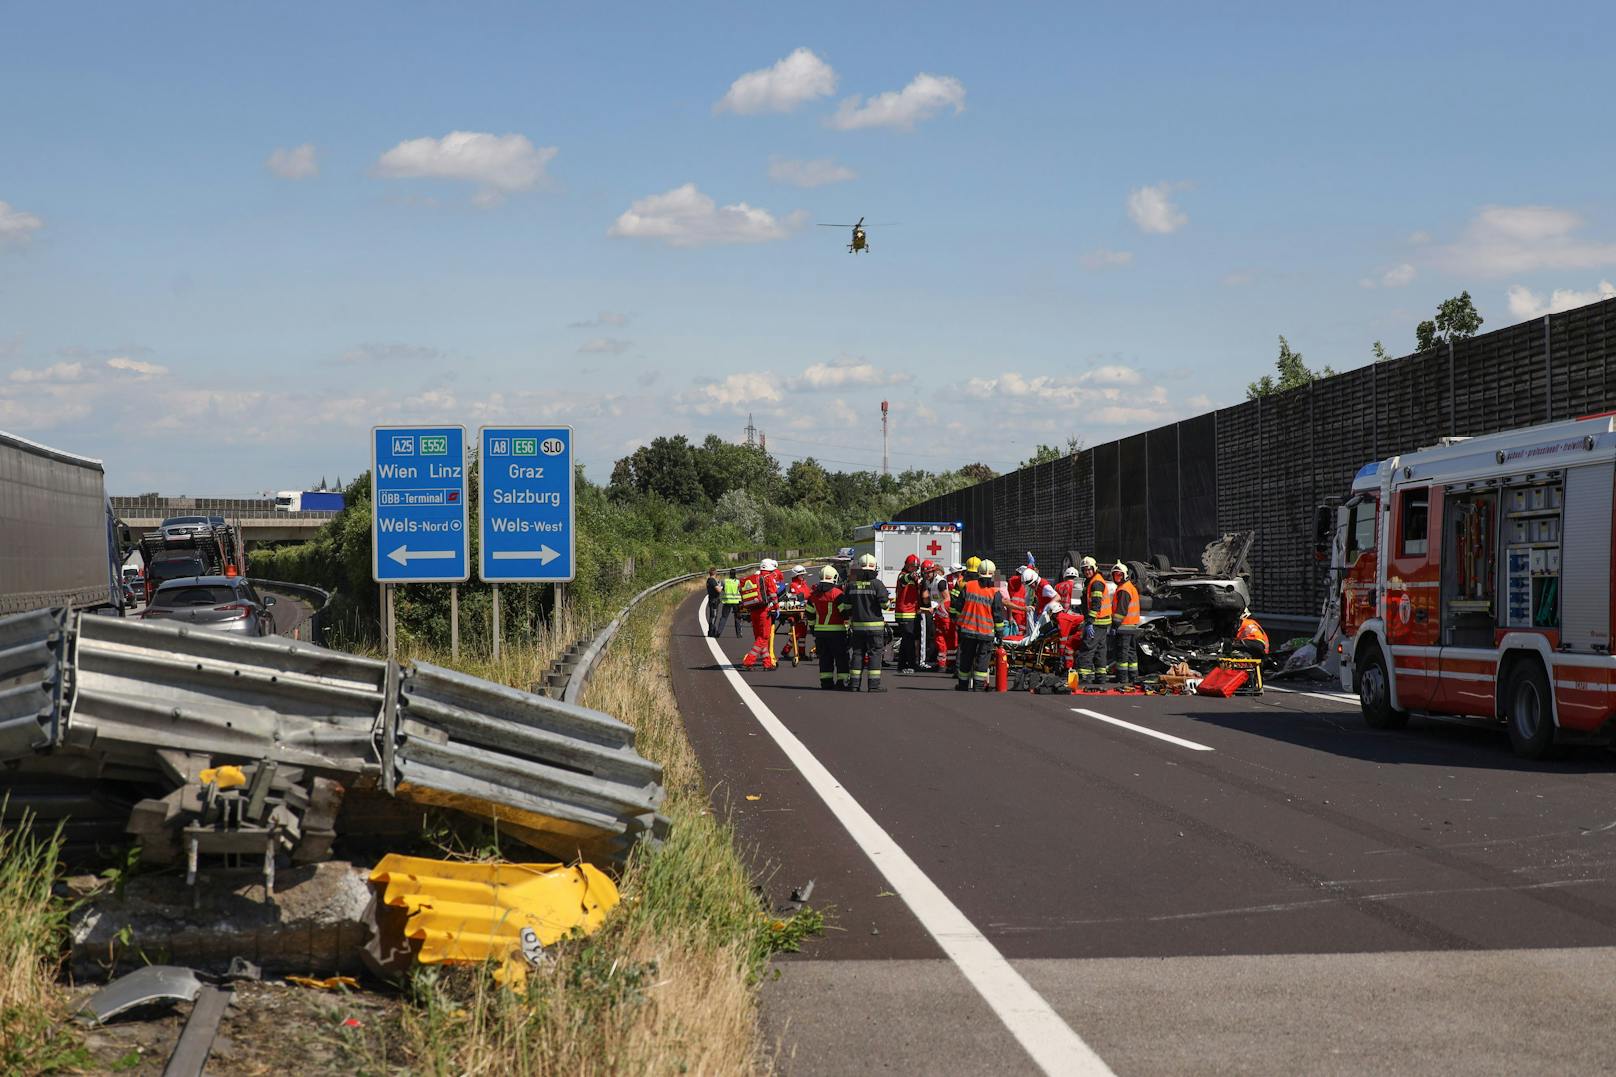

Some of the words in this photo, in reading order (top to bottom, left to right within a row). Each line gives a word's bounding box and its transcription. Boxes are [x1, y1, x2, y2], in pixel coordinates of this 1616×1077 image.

[394, 439, 412, 452] A25
[422, 439, 445, 452] E552
[493, 441, 506, 453] A8
[515, 441, 534, 453] E56
[543, 441, 562, 453] SLO
[378, 464, 417, 478] Wien
[430, 464, 461, 478] Linz
[509, 464, 544, 478] Graz
[381, 491, 443, 504] ÖBB-Terminal
[493, 489, 560, 507] Salzburg
[379, 518, 449, 532] Wels-Nord
[491, 518, 563, 532] Wels-West
